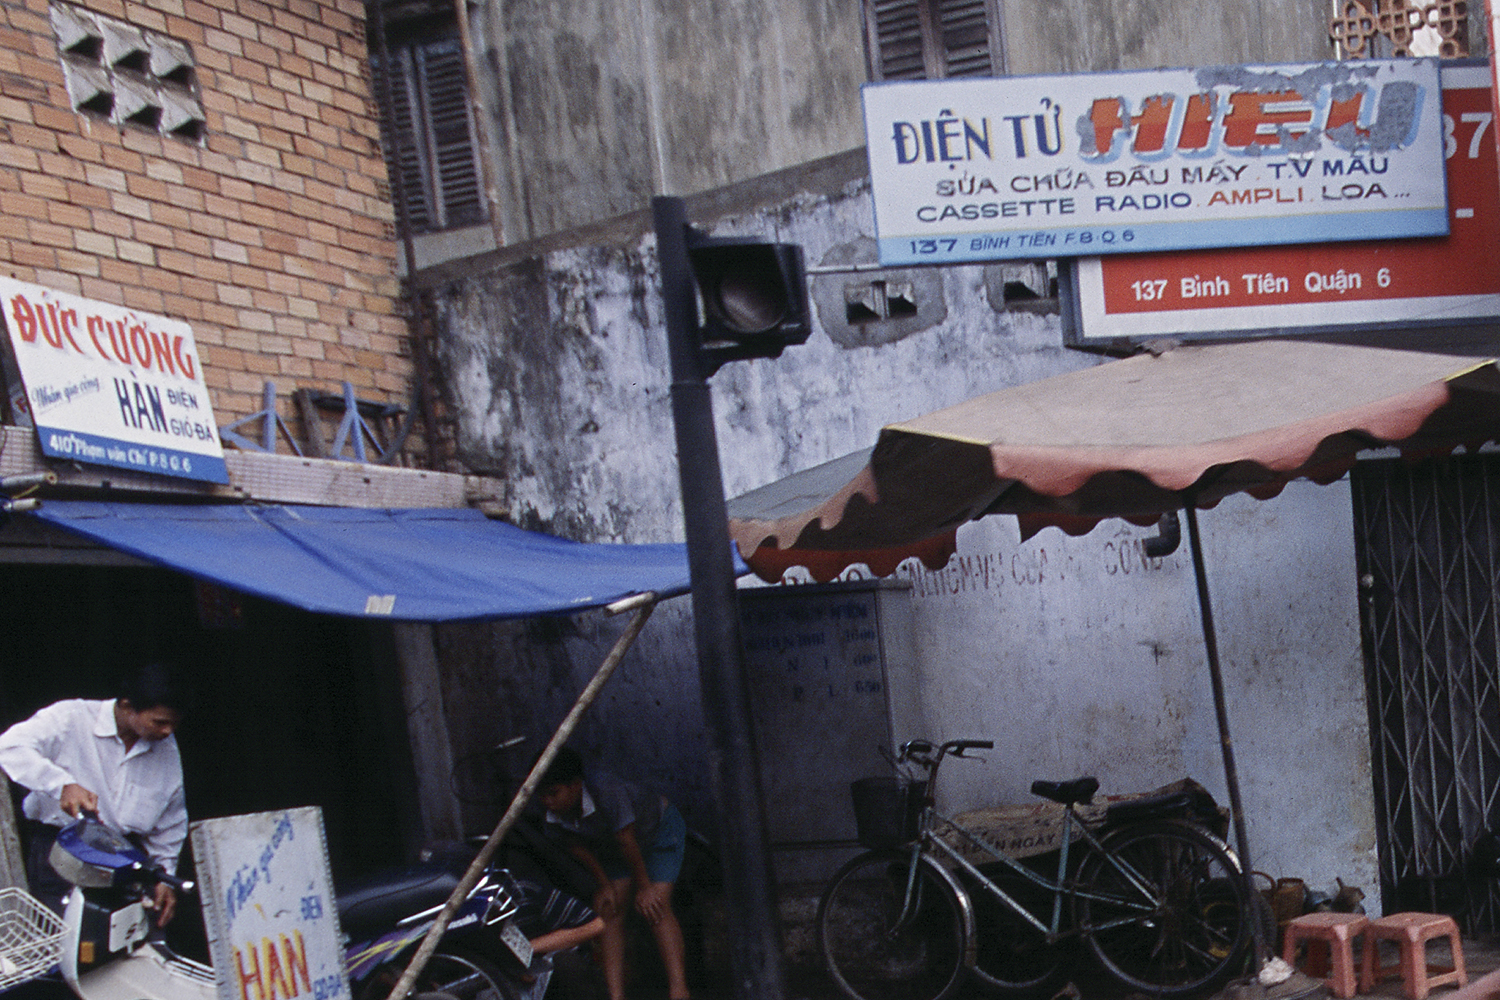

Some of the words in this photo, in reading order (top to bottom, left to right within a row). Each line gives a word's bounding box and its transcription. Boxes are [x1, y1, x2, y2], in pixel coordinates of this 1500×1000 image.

[892, 108, 991, 170] ĐIỆN
[1003, 96, 1063, 158] TỬ
[916, 198, 1076, 222] CASSETTE
[910, 238, 957, 254] 137
[1131, 281, 1167, 301] 137
[1180, 275, 1230, 299] Bình
[1242, 274, 1289, 294] Tiên
[1304, 269, 1362, 294] Quận
[1377, 269, 1391, 288] 6
[10, 291, 83, 354] ĐỨC
[86, 311, 195, 380] CƯỜNG
[113, 370, 168, 434] HÀN
